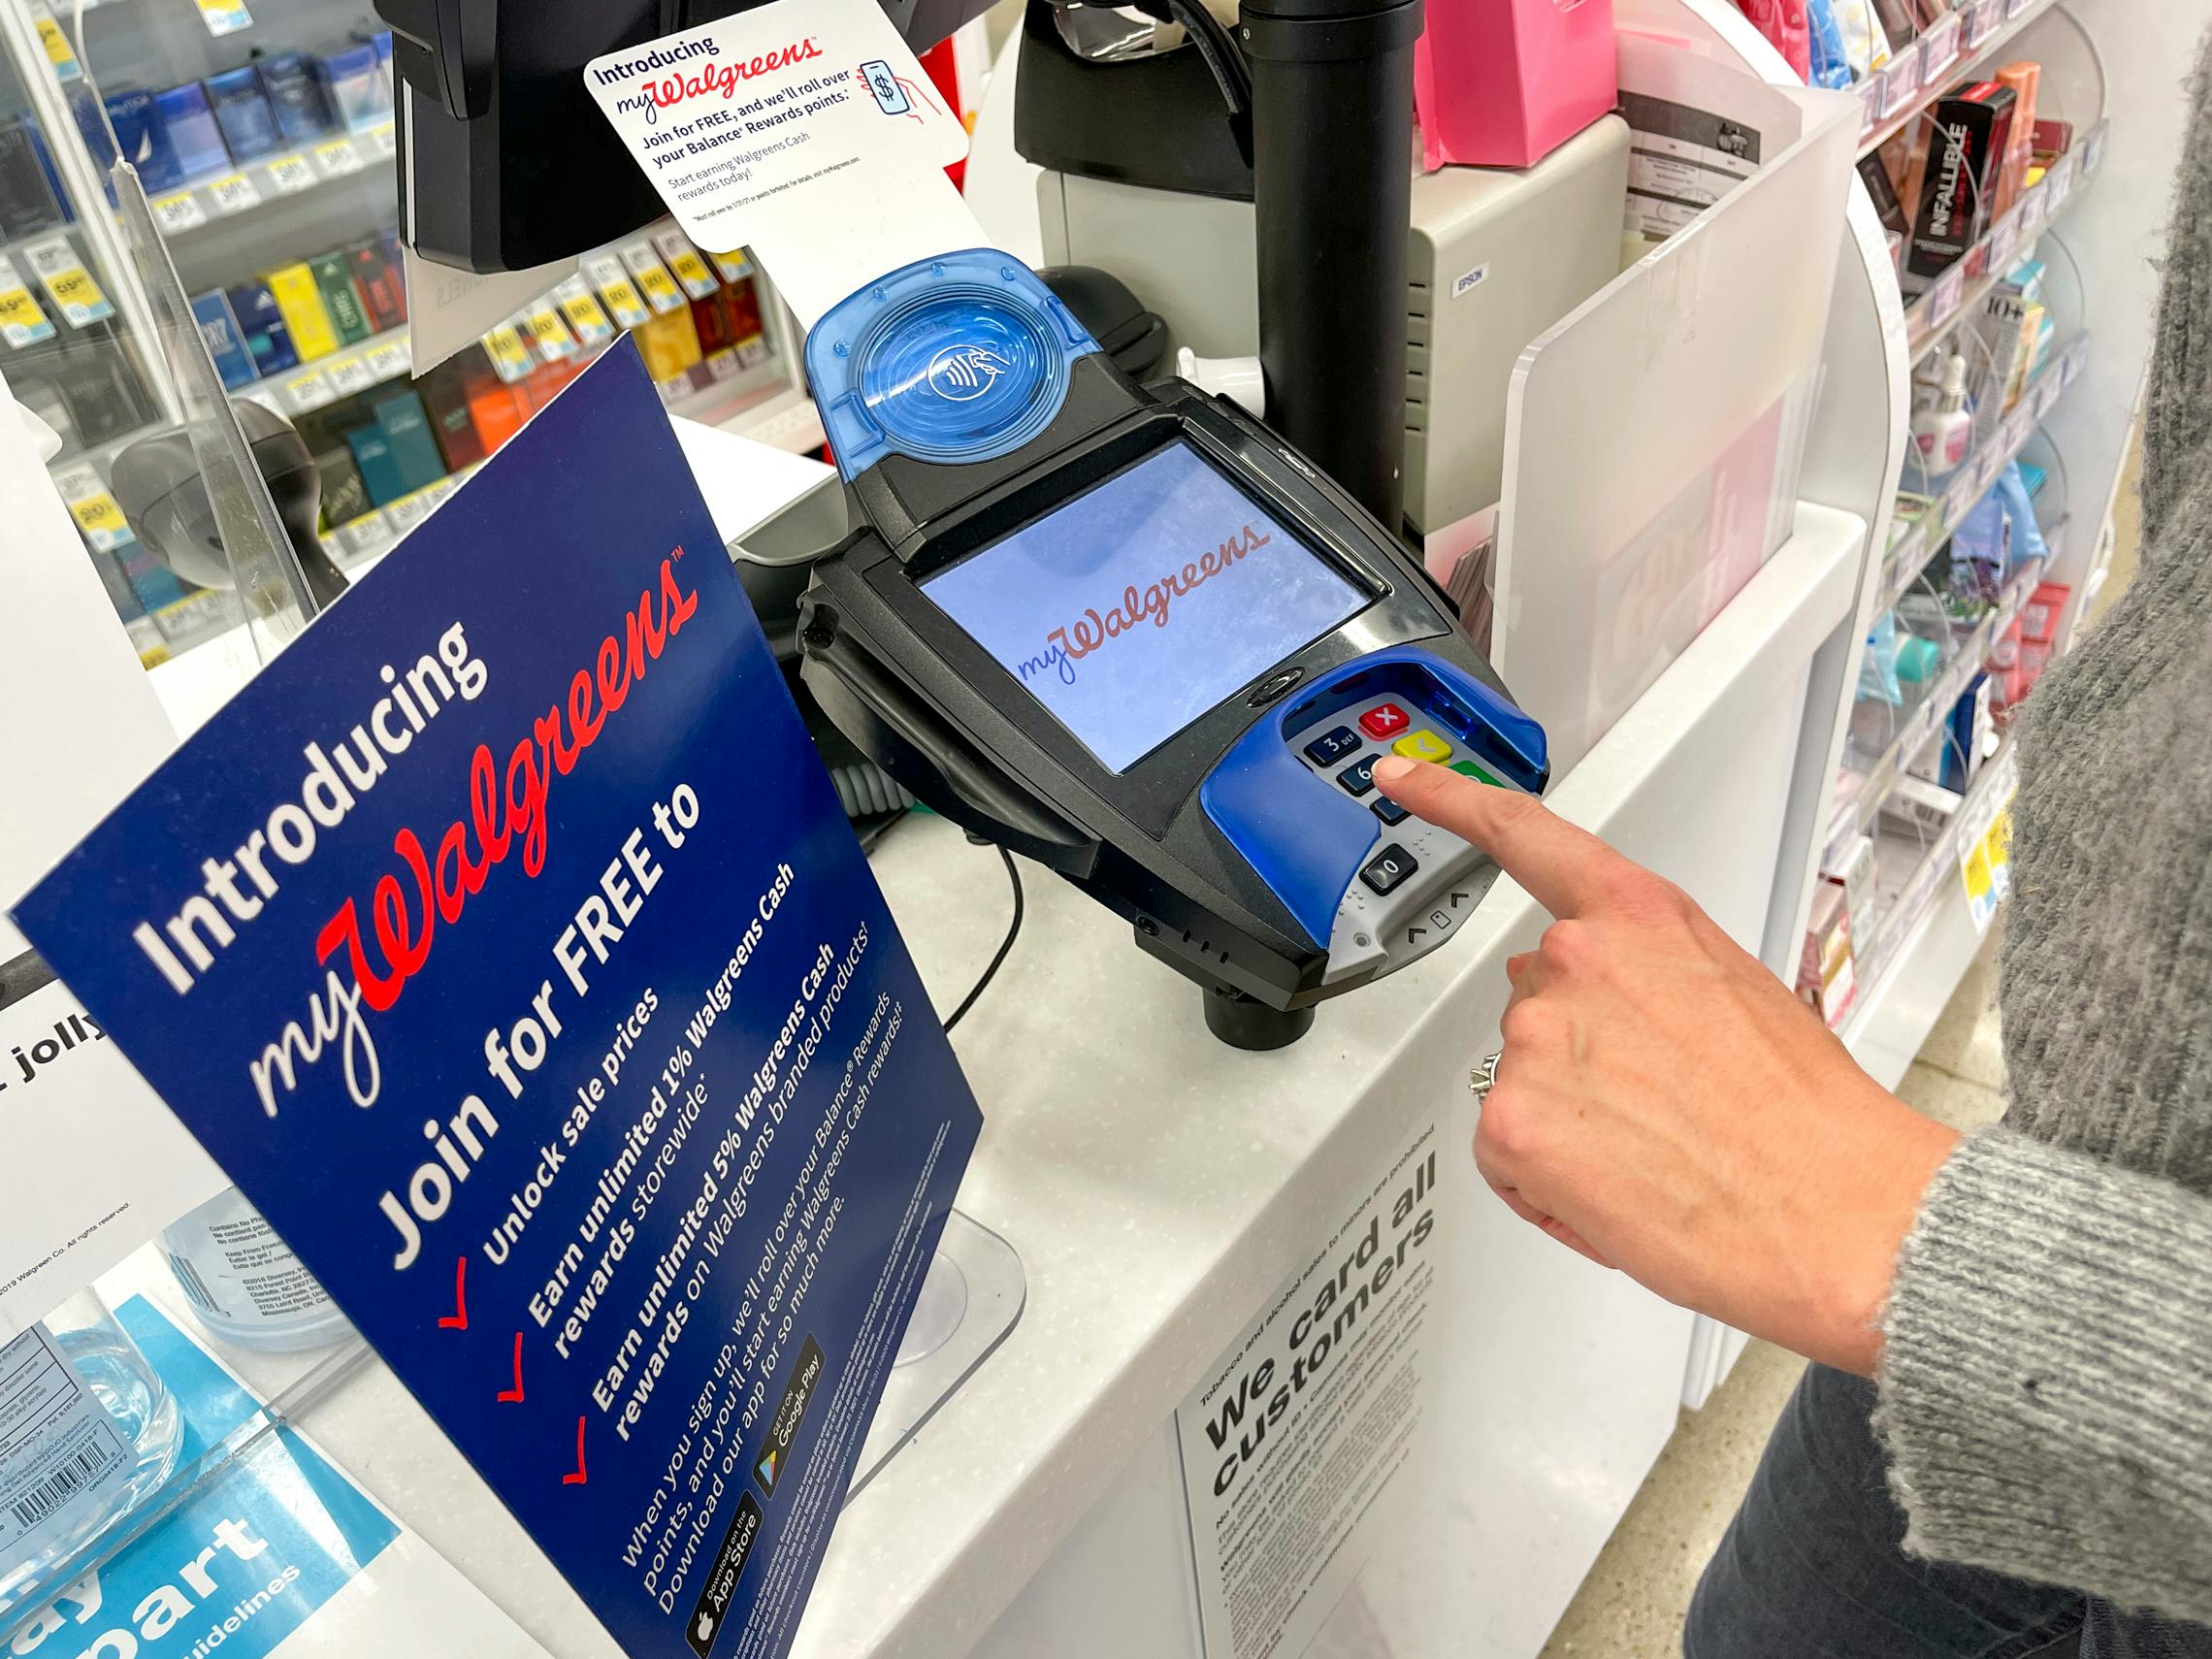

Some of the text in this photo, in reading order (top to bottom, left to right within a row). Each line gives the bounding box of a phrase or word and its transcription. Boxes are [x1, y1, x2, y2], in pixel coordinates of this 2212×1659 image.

[593, 37, 720, 85] Introducing
[642, 70, 850, 148] Join for FREE, and we'll roll over
[652, 147, 685, 169] your
[744, 107, 803, 134] Rewards
[667, 132, 810, 188] Start earning Walgreens Cash
[677, 167, 752, 201] rewards today!
[1929, 121, 1968, 237] INFALLIBLE
[756, 190, 770, 200] points
[1458, 267, 1482, 291] EPSON
[1324, 732, 1356, 753] 3 DEF
[1358, 765, 1372, 781] 6
[133, 621, 487, 993] Introducing
[1382, 859, 1399, 874] 0
[378, 783, 699, 1270] Join for FREE to
[483, 987, 658, 1264] Unlock sale prices
[528, 863, 794, 1327] Earn unlimited 1% Walgreens Cash
[592, 944, 833, 1412] Earn unlimited 5% Walgreens Cash
[16, 1256, 52, 1282] Walgreen
[67, 1239, 78, 1249] All
[78, 1224, 98, 1241] rights
[616, 1300, 688, 1441] rewards
[687, 1259, 710, 1300] on
[703, 1122, 774, 1256] Walgreens
[767, 1016, 822, 1123] branded
[1200, 1122, 1434, 1406] Tobacco and alcohol sales to minors are prohibited
[555, 1218, 634, 1358] rewards
[622, 1488, 667, 1567] When
[663, 1434, 691, 1491] you
[689, 1380, 716, 1433] sign
[713, 1344, 736, 1378] up,
[732, 1277, 761, 1335] we'll
[757, 1238, 777, 1282] roll
[775, 1191, 797, 1242] over
[795, 1145, 818, 1200] your
[853, 992, 890, 1066] Rewards
[1205, 1150, 1435, 1450] We card all
[643, 1501, 692, 1596] points,
[688, 1436, 715, 1492] and
[711, 1367, 745, 1445] you'll
[742, 1312, 770, 1371] start
[768, 1228, 807, 1312] earning
[800, 1129, 849, 1229] Walgreens
[846, 1084, 869, 1129] Cash
[1214, 1209, 1433, 1496] customers
[659, 1196, 844, 1614] Download our app for so much more.
[772, 1389, 793, 1435] GET IT ON
[778, 1353, 819, 1447] Google Play
[34, 1494, 68, 1522] 49022
[706, 1511, 746, 1600] Download on the
[713, 1514, 756, 1612] App Store
[782, 1589, 798, 1627] checkout
[797, 1555, 811, 1589] counters
[810, 1521, 823, 1550] Display
